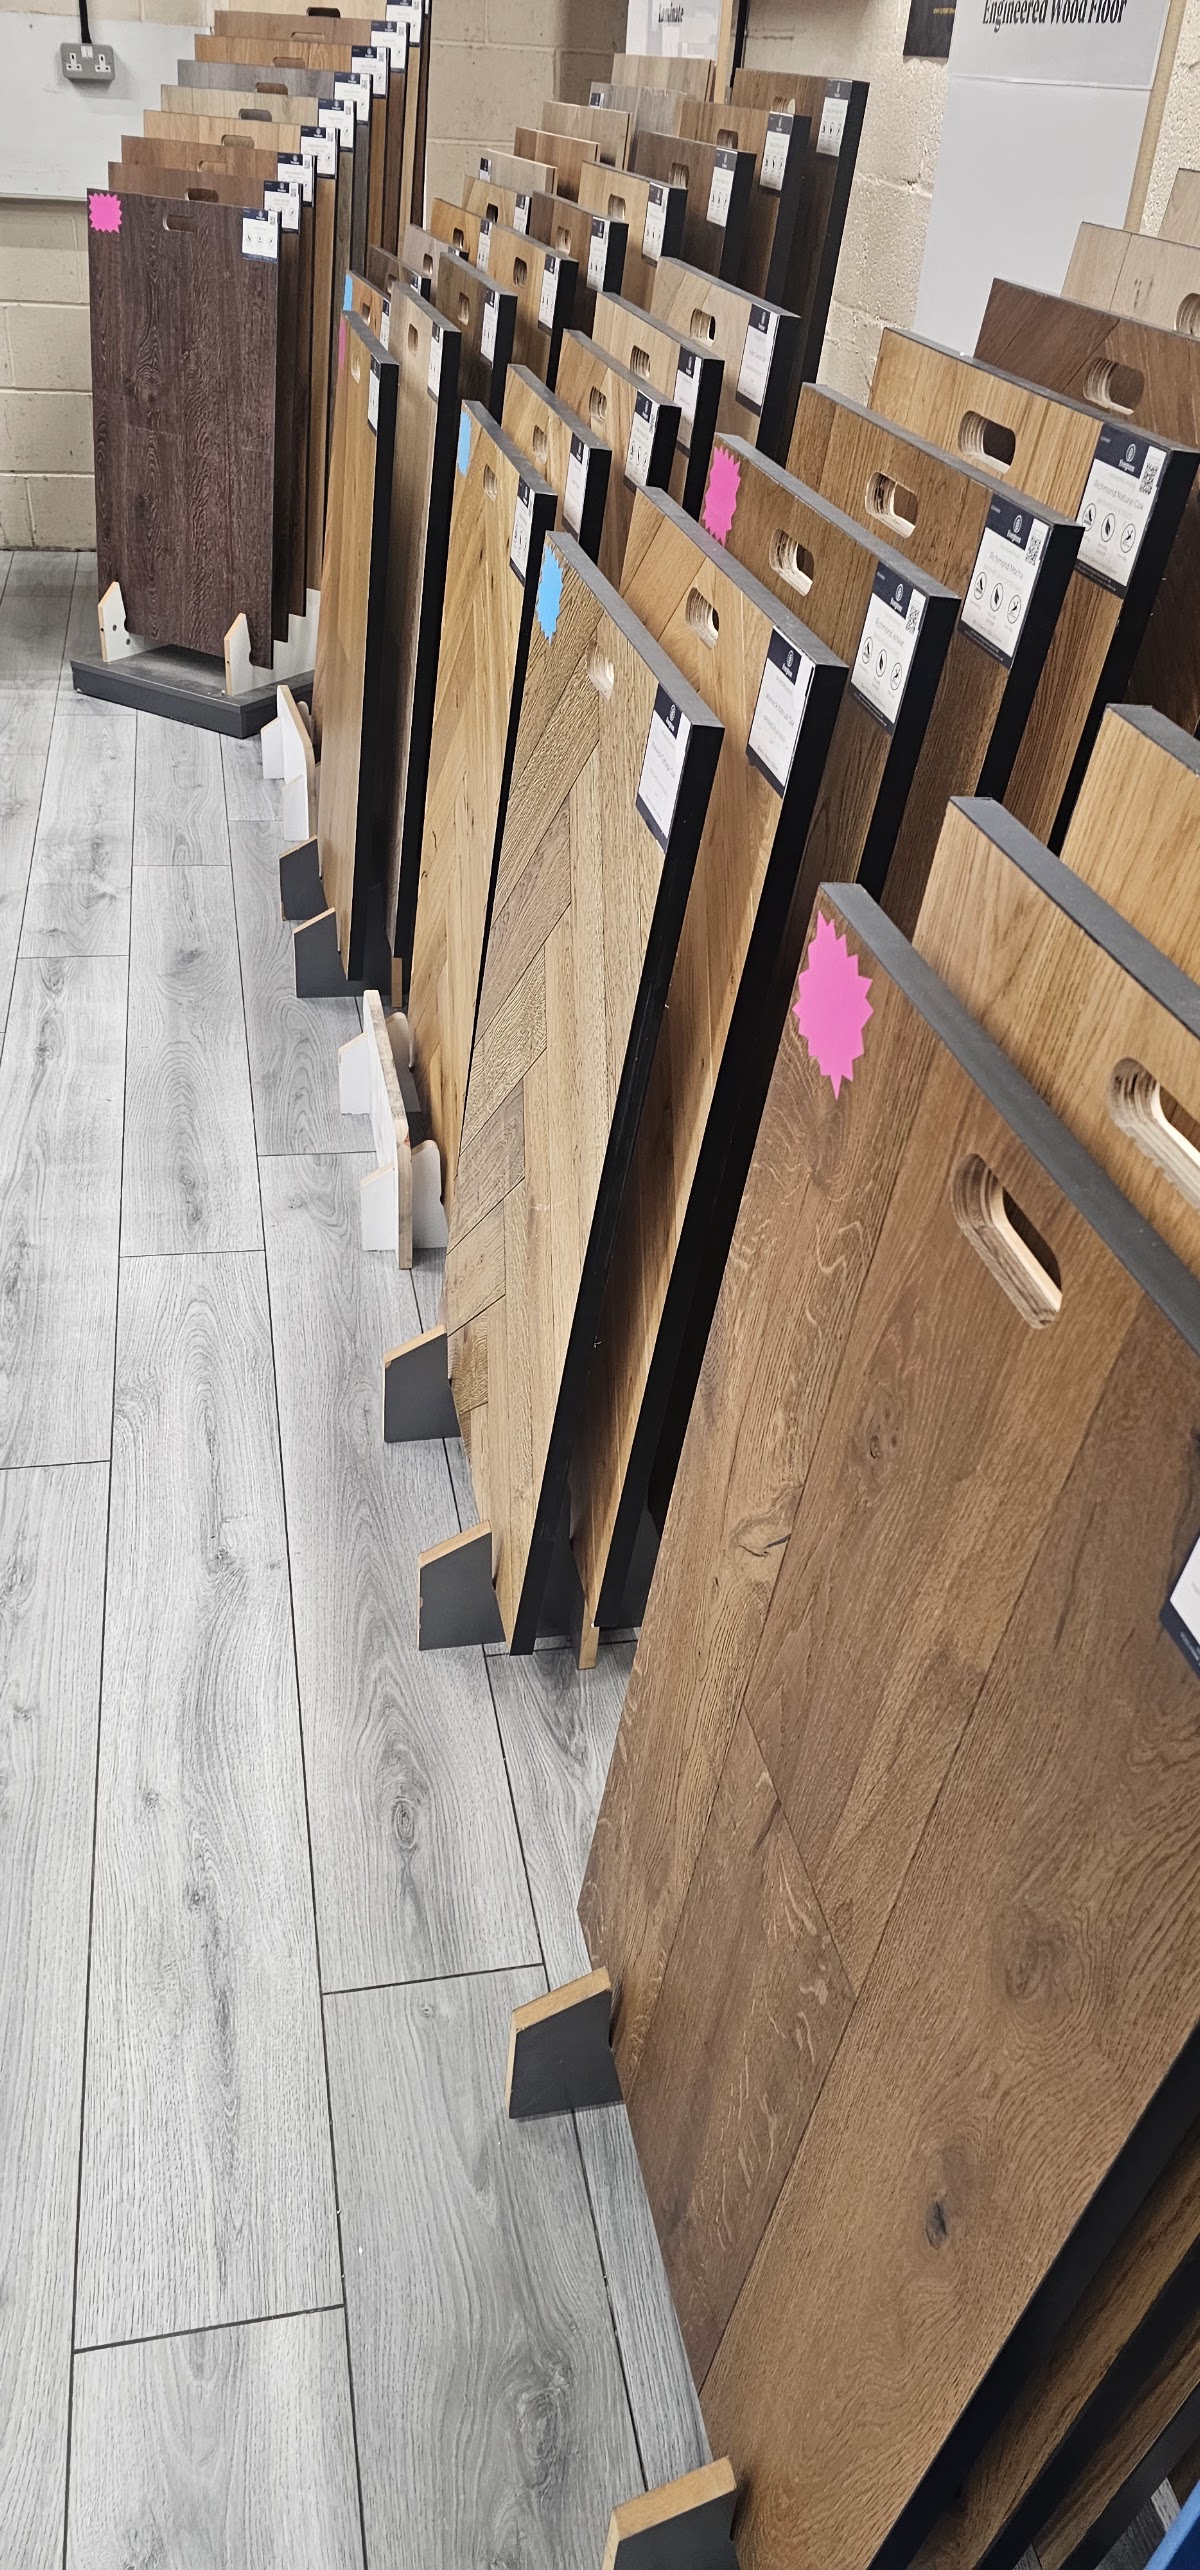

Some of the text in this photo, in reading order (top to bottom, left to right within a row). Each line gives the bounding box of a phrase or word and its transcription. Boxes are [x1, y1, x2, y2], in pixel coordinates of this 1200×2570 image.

[982, 0, 1129, 33] Engineered Wood Floor
